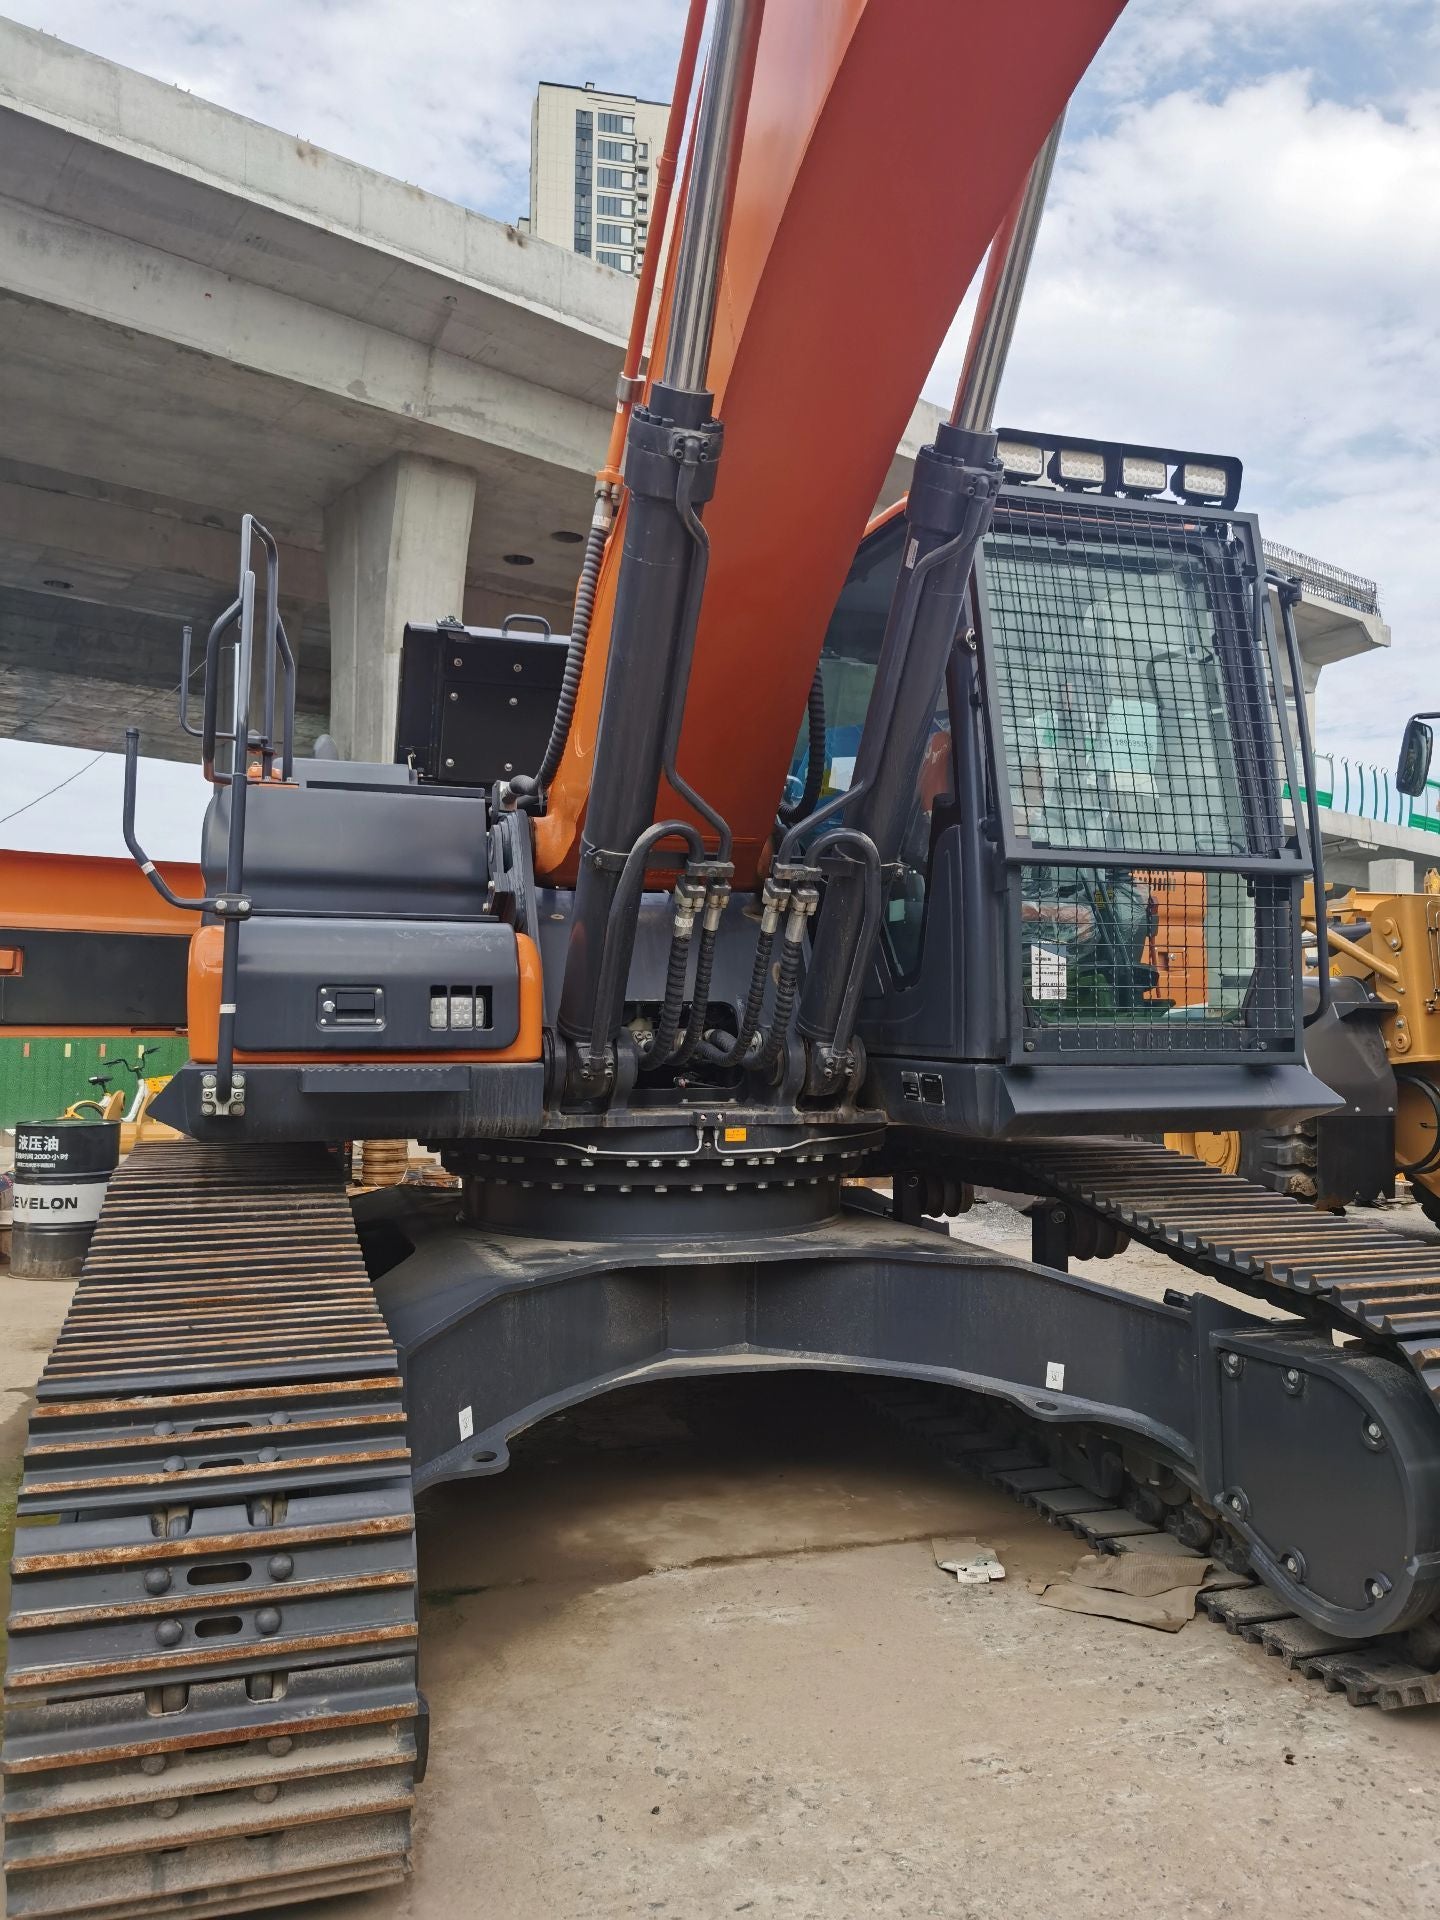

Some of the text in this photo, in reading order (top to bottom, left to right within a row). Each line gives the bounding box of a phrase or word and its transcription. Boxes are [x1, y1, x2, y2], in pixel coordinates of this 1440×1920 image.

[18, 1134, 60, 1151] 液压油
[13, 1195, 78, 1209] EVELON
